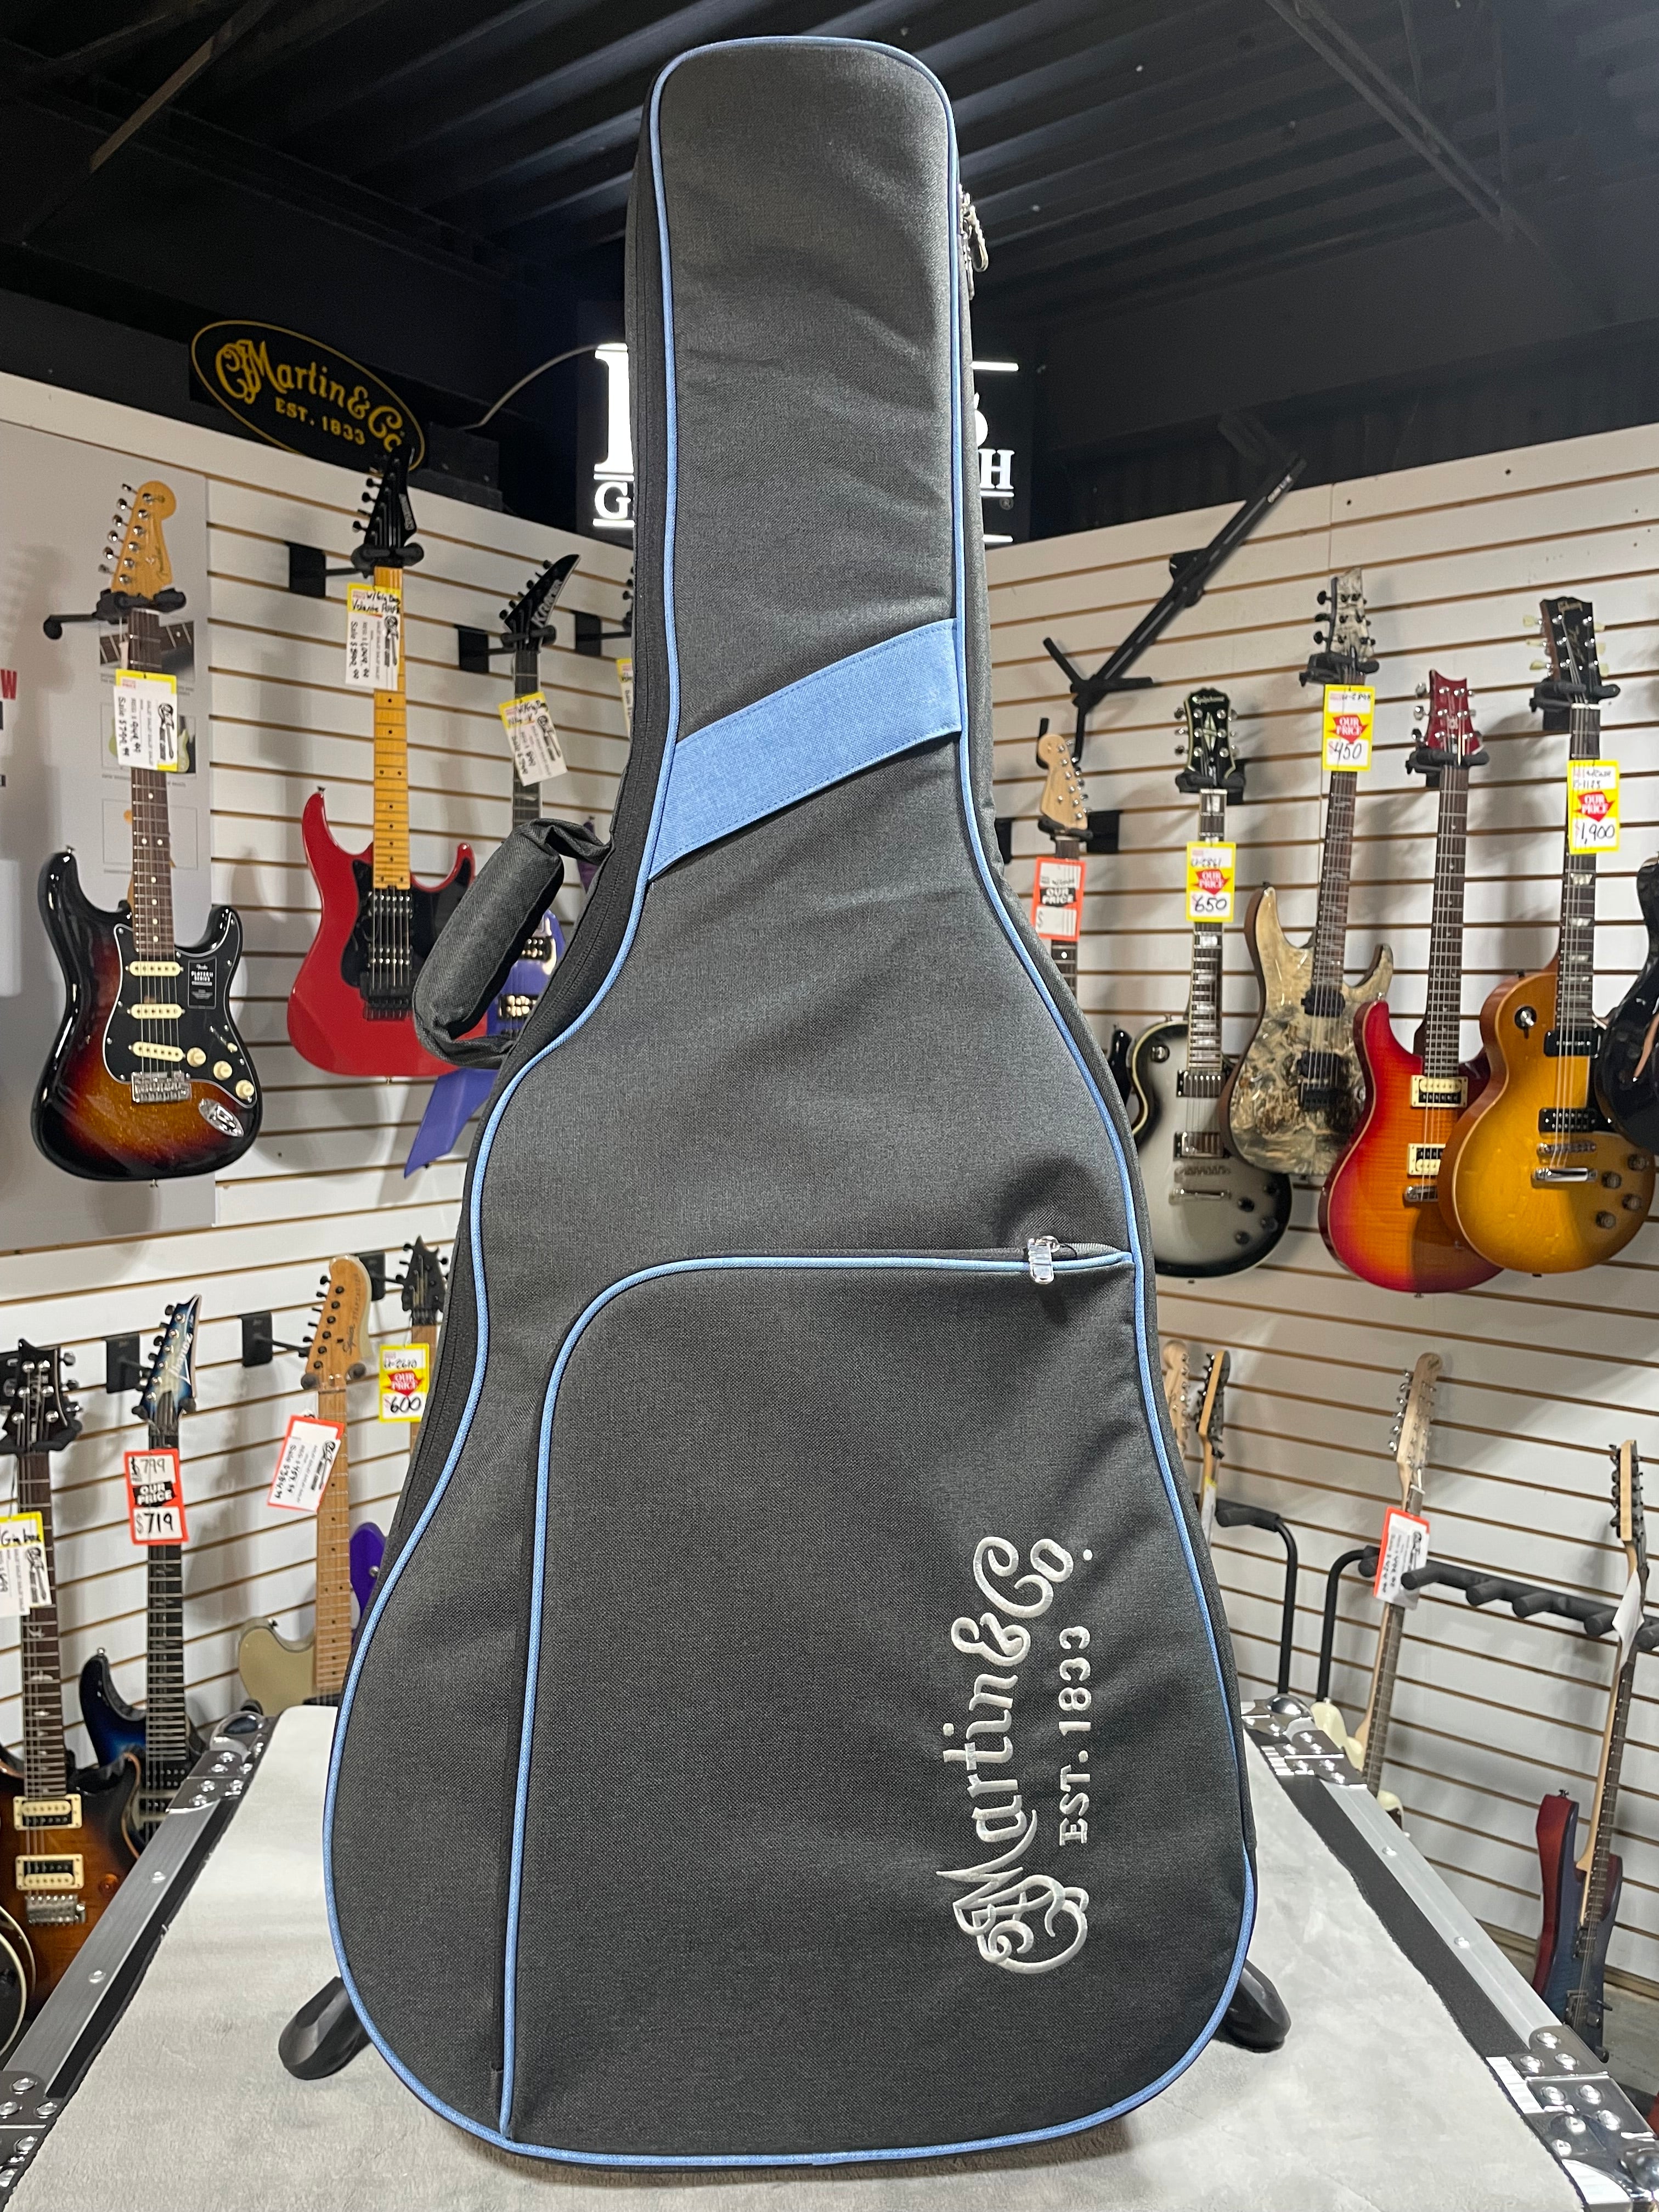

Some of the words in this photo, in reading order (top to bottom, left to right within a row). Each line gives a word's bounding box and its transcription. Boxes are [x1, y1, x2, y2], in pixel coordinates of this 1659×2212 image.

[276, 396, 317, 426] EST.
[321, 415, 365, 445] 1833
[1339, 717, 1359, 726] OUR
[1336, 725, 1362, 736] PRICE
[1584, 793, 1605, 804] OUR
[1581, 803, 1609, 815] PRICE
[1201, 870, 1222, 879] OUR
[1199, 877, 1224, 889] PRICE
[1046, 887, 1069, 896] OUR
[1042, 895, 1074, 905] PRICE
[395, 1373, 415, 1381] OUR
[391, 1380, 418, 1390] PRICE
[139, 1483, 166, 1494] OUR
[137, 1489, 173, 1505] PRICE
[136, 1512, 174, 1534] $719
[1058, 1626, 1092, 1737] 1833
[1059, 1750, 1092, 1846] EST.
